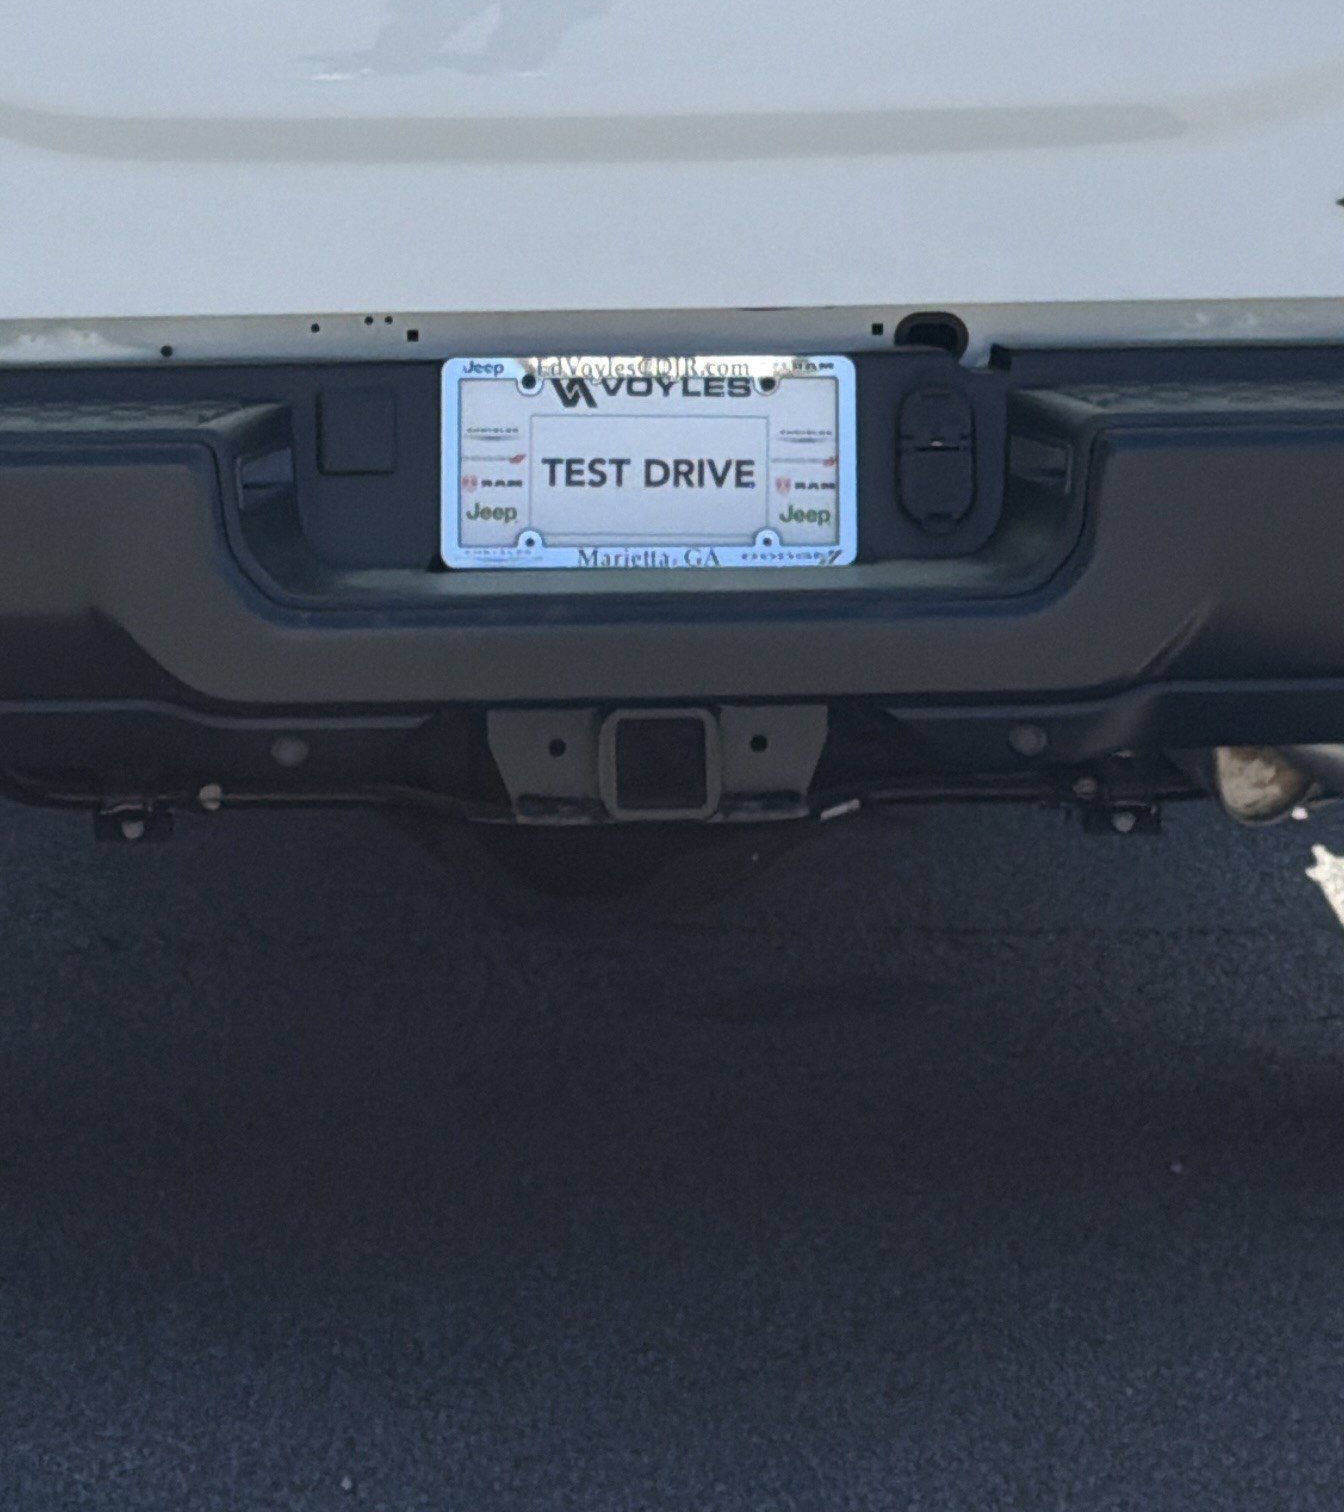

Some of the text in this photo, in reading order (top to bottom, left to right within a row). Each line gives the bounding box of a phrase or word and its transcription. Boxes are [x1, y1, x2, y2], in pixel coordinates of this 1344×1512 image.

[463, 360, 505, 376] Jeep
[602, 377, 752, 398] VOYLES
[542, 458, 755, 489] TEST DRIVE
[465, 502, 518, 524] Jeep
[778, 504, 831, 526] Jeep
